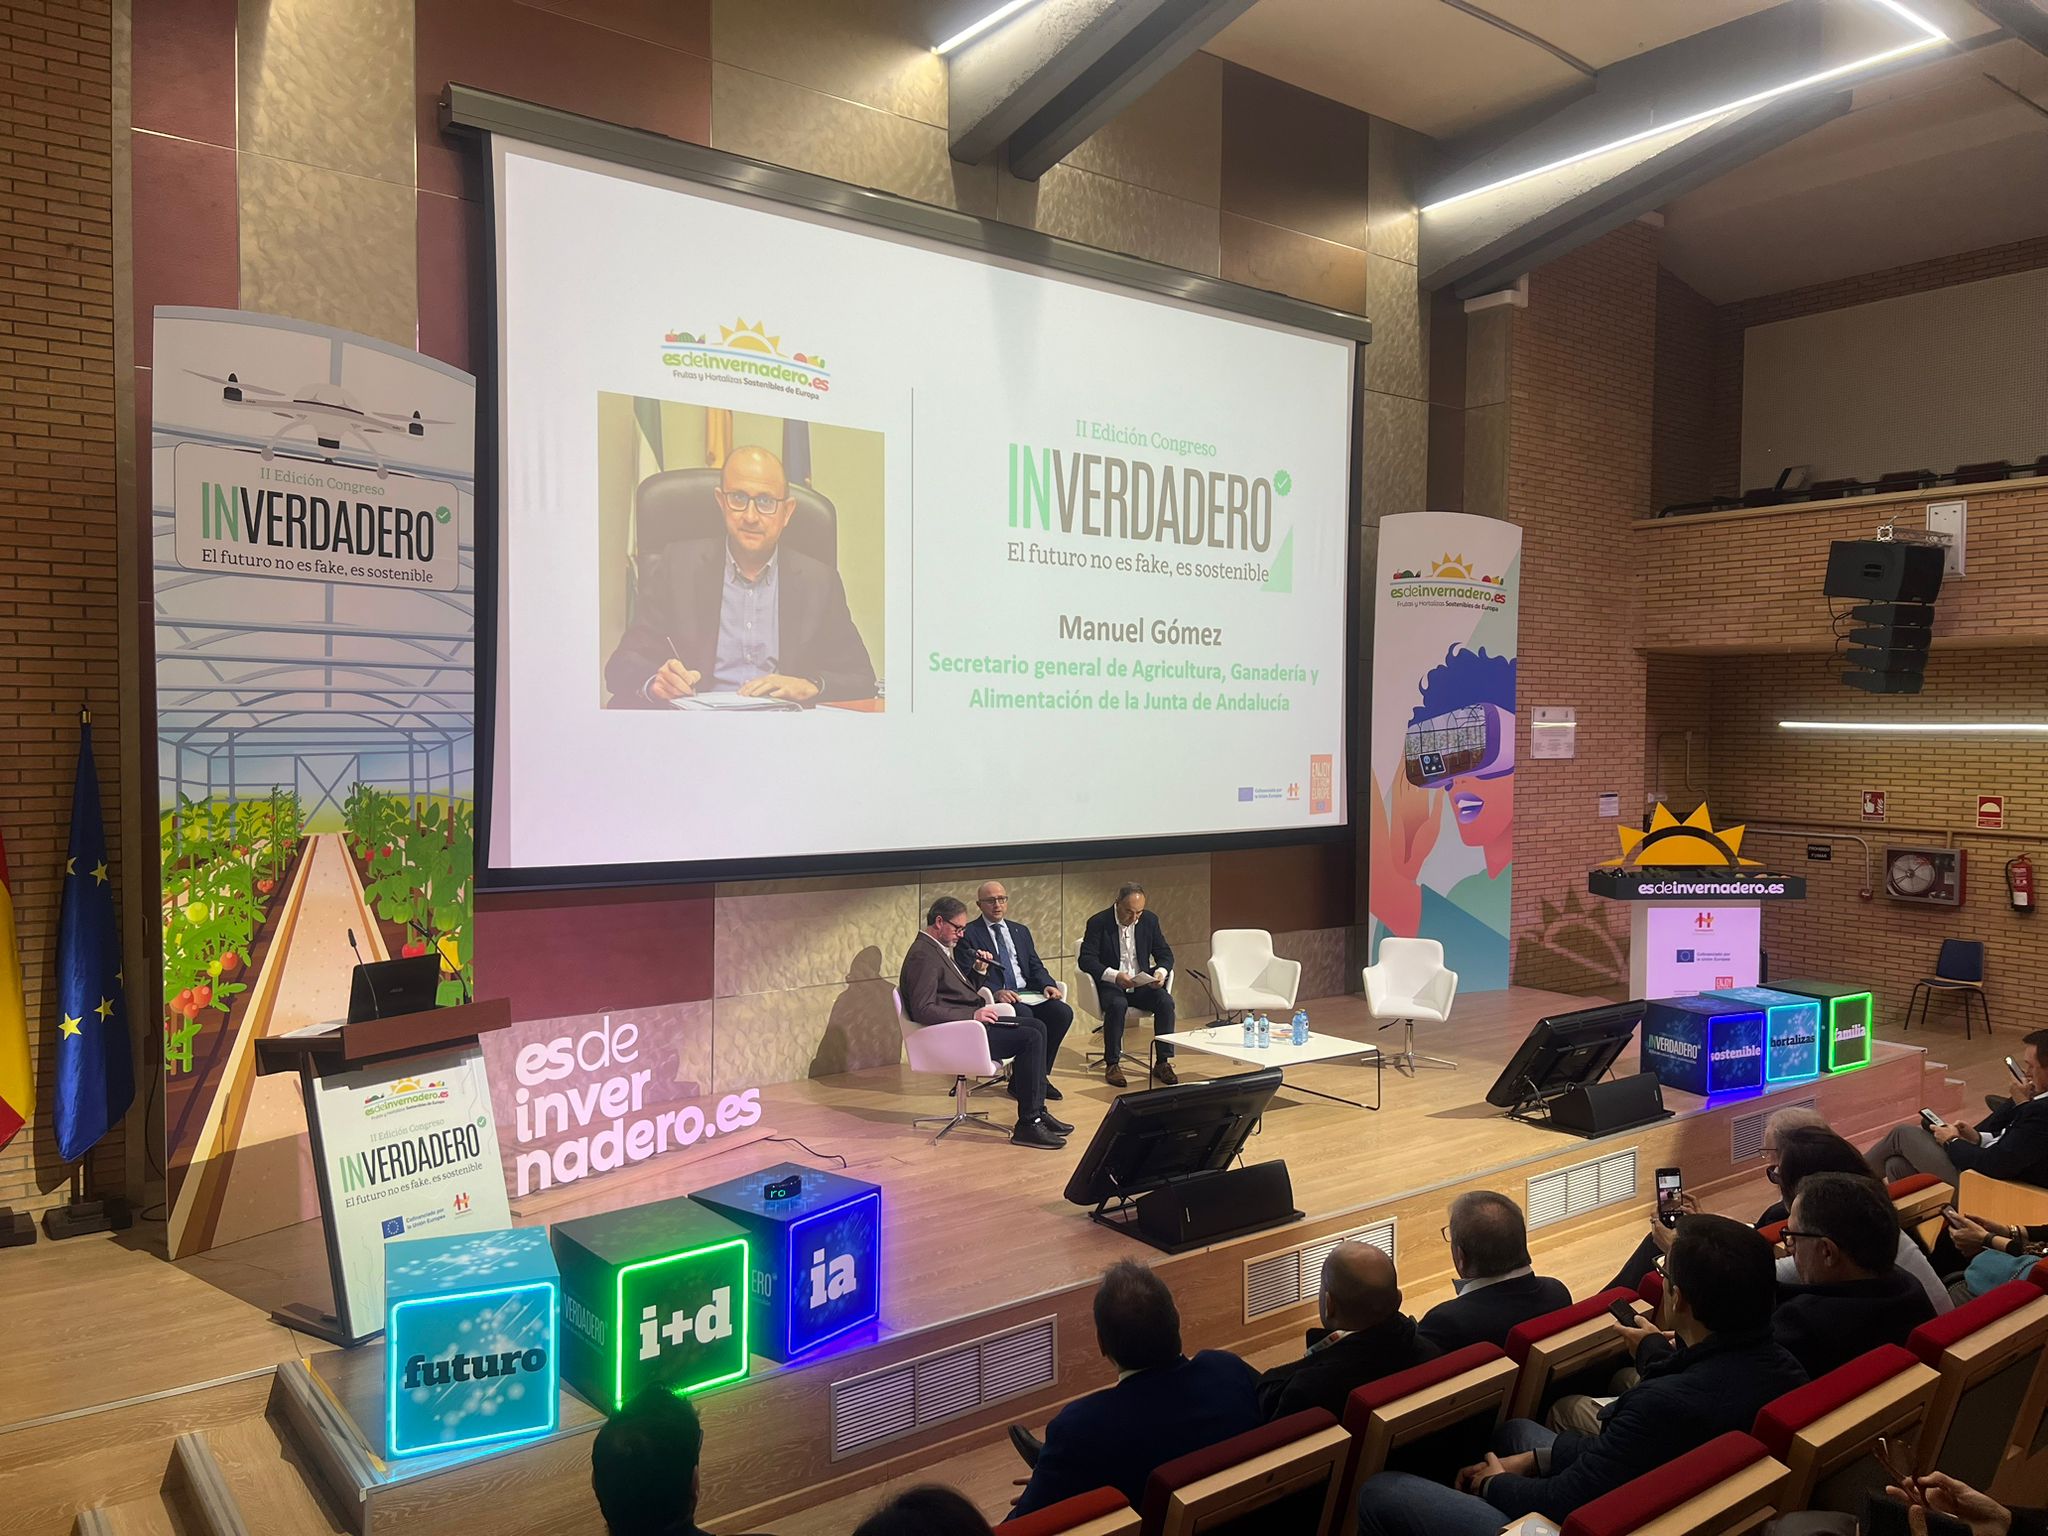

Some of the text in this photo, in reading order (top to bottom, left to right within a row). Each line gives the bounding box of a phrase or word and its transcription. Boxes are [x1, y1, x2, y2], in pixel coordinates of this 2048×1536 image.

[662, 351, 829, 392] esdeinvernadero.es
[672, 369, 820, 400] Frutas y Hortalizas Sostenibles de Europa
[1075, 418, 1217, 458] II Edición Congreso
[260, 466, 385, 496] II Edición Congreso
[1008, 442, 1272, 553] INVERDADERO
[202, 481, 434, 562] INVERDADERO
[202, 548, 433, 583] El futuro no es fake, es sostenible
[1007, 541, 1269, 583] El futuro no es fake, es sostenible
[1390, 584, 1506, 604] esdeinvernadero.es
[1397, 600, 1414, 608] Frutas
[1419, 600, 1445, 608] Hortalizas
[1445, 601, 1474, 609] Sostenibles
[1481, 604, 1499, 613] Europa
[1059, 614, 1222, 646] Manuel Gómez
[929, 651, 1319, 686] Secretario general de Agricultura, Ganadería y
[969, 688, 1290, 712] Alimentación de la Junta de Andalucía
[1638, 880, 1785, 895] esdeinvernadero.es
[516, 1015, 639, 1086] esde
[1649, 1034, 1697, 1059] INVERDADERO
[1770, 1034, 1815, 1048] hortalizas
[365, 1091, 449, 1116] esdeinvernadero.es
[516, 1068, 651, 1142] inver
[378, 1126, 408, 1141] Edición
[409, 1118, 445, 1133] Congreso
[516, 1088, 762, 1196] nadero.es
[339, 1123, 480, 1193] INVERDADERO
[345, 1162, 483, 1208] El futuro no es fake, es sostenible
[770, 1189, 786, 1198] ro
[810, 1248, 857, 1310] ia
[563, 1291, 605, 1346] VERDADERO
[639, 1286, 732, 1361] i+d
[404, 1347, 547, 1389] futuro
